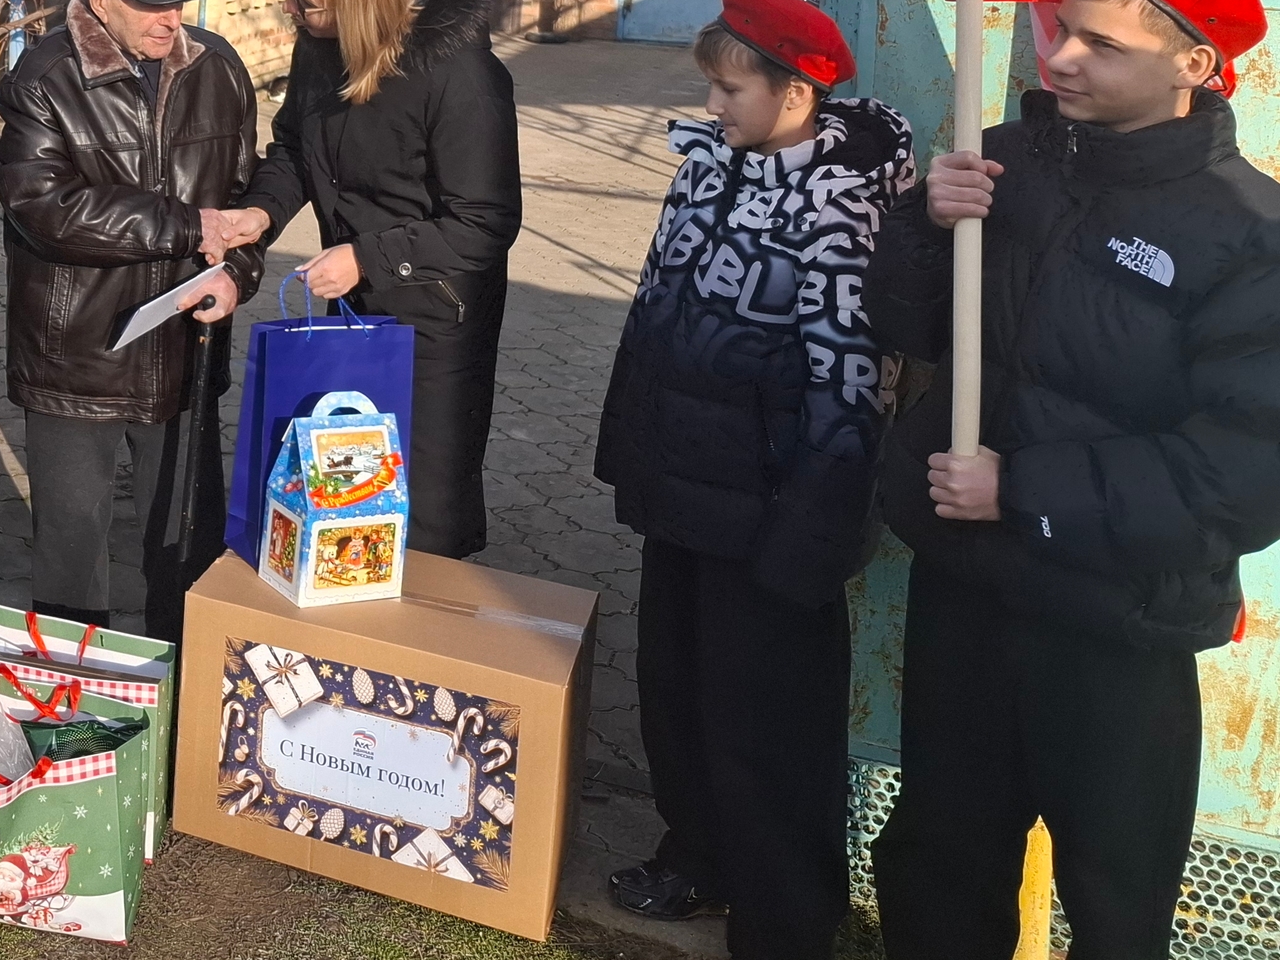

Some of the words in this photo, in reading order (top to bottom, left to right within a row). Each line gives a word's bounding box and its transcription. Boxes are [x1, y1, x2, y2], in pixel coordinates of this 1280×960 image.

[1107, 237, 1155, 268] NORTH
[1132, 236, 1159, 257] THE
[1115, 253, 1150, 276] FACE
[1040, 515, 1052, 538] 700
[279, 739, 294, 757] С
